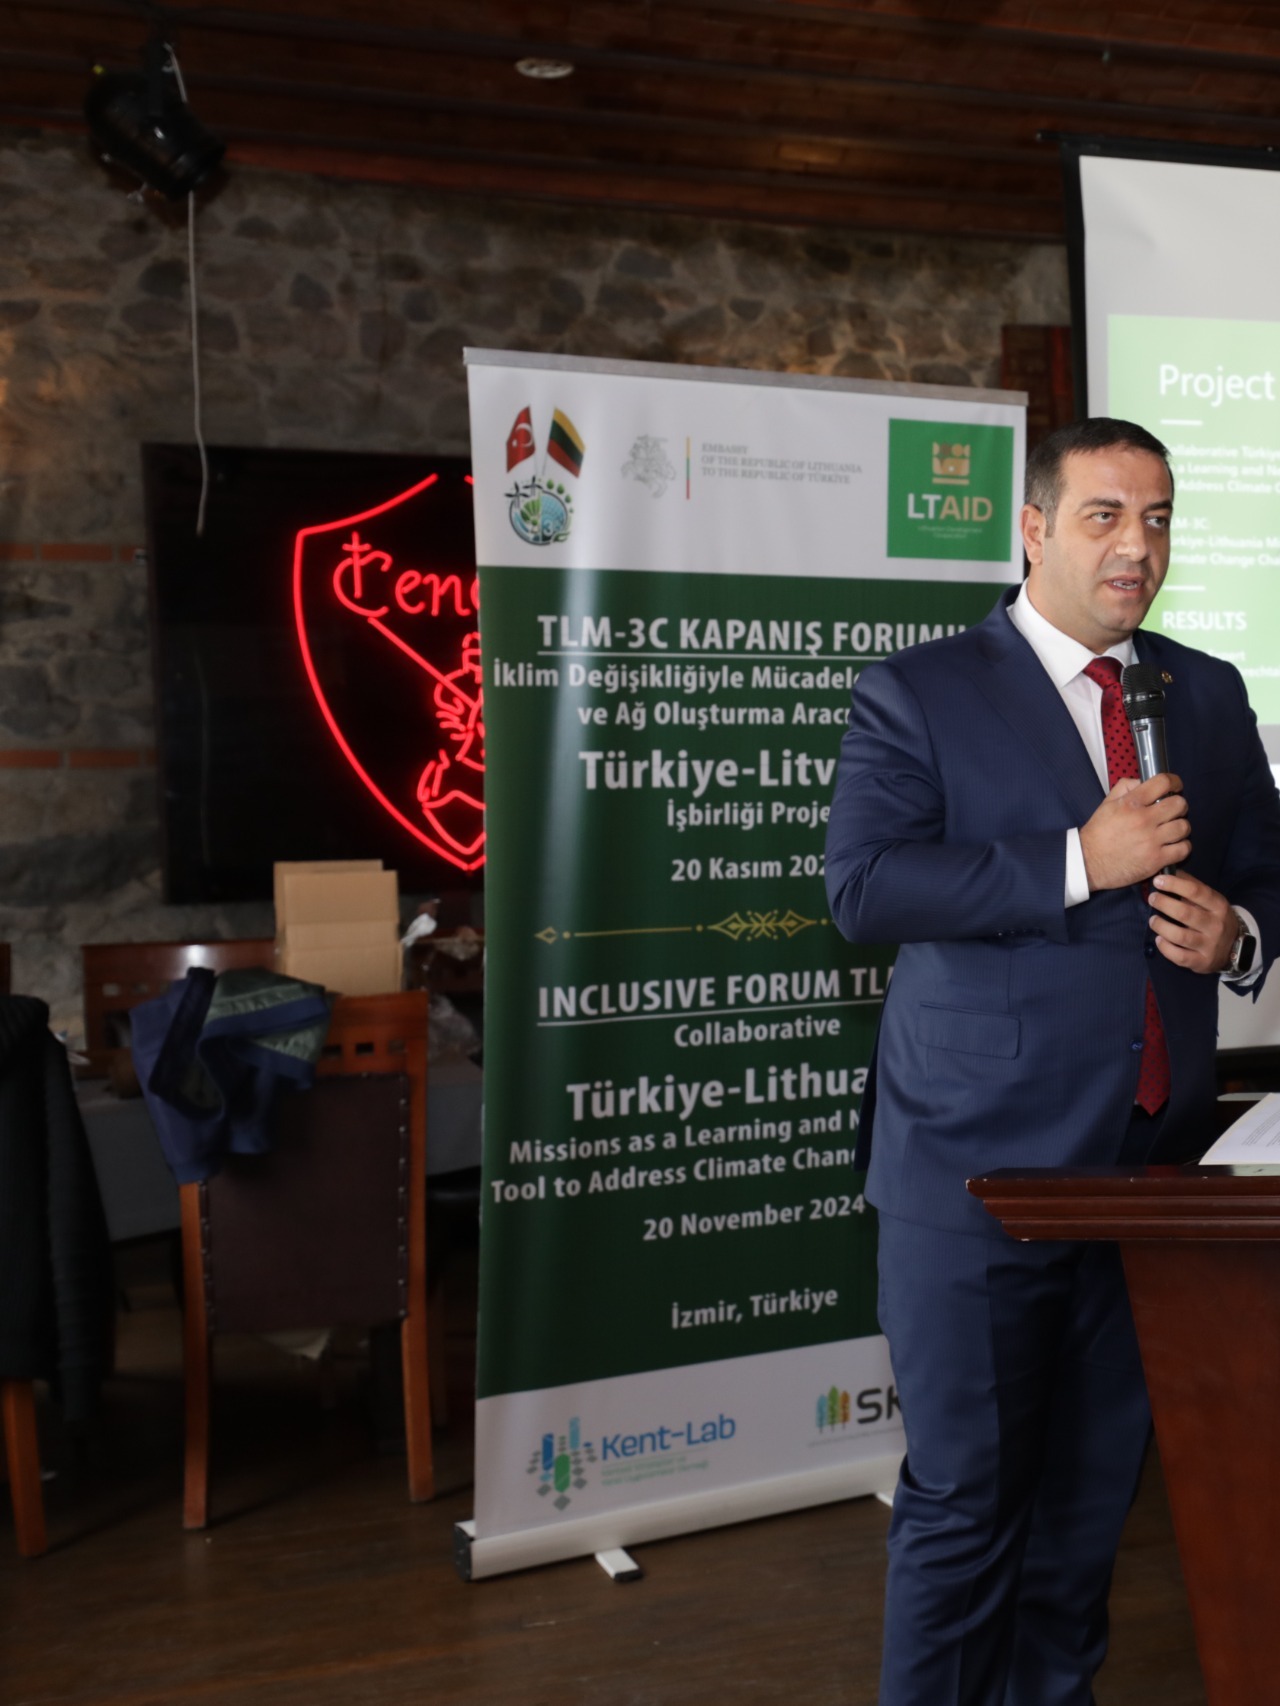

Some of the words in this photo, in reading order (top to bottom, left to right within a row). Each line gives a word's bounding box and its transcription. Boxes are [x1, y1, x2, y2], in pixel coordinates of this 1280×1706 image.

[1160, 364, 1276, 407] Project
[701, 443, 748, 454] EMBASSY
[1164, 443, 1238, 458] ollaborative
[701, 455, 715, 464] OF
[719, 456, 738, 466] THE
[741, 457, 790, 469] REPUBLIC
[807, 461, 862, 473] LITHUANIA
[701, 467, 716, 476] TO
[719, 468, 738, 477] THE
[741, 469, 790, 480] REPUBLIC
[1187, 463, 1238, 477] Learning
[1241, 465, 1264, 476] and
[1178, 479, 1224, 492] Address
[1227, 480, 1272, 493] Climate
[908, 493, 993, 521] LTAID
[1210, 553, 1254, 568] Change
[538, 615, 669, 649] TLM-3C
[680, 618, 823, 656] KAPANIŞ
[1162, 611, 1247, 630] RESULTS
[493, 658, 558, 687] İklim
[570, 662, 743, 694] Değişikliğiyle
[752, 664, 859, 689] Mücadel
[578, 707, 608, 725] ve
[615, 702, 646, 730] Ağ
[654, 702, 785, 730] Oluşturma
[667, 799, 763, 831] İşbirliği
[671, 859, 702, 881] 20
[709, 857, 782, 879] Kasım
[539, 976, 716, 1018] INCLUSIVE
[727, 969, 840, 1005] FORUM
[850, 966, 895, 997] TL
[674, 1016, 841, 1048] Collaborative
[510, 1134, 621, 1164] Missions
[628, 1133, 655, 1153] as
[662, 1131, 677, 1149] a
[685, 1116, 792, 1147] Learning
[799, 1109, 842, 1135] and
[491, 1176, 546, 1203] Tool
[554, 1175, 581, 1198] to
[588, 1165, 686, 1194] Address
[693, 1150, 786, 1182] Climate
[793, 1147, 855, 1171] Chan
[643, 1217, 673, 1241] 20
[681, 1203, 804, 1236] November
[809, 1193, 865, 1220] 2024
[671, 1301, 743, 1330] İzmir,
[750, 1286, 838, 1318] Türkiye
[601, 1413, 736, 1461] Kent-Lab
